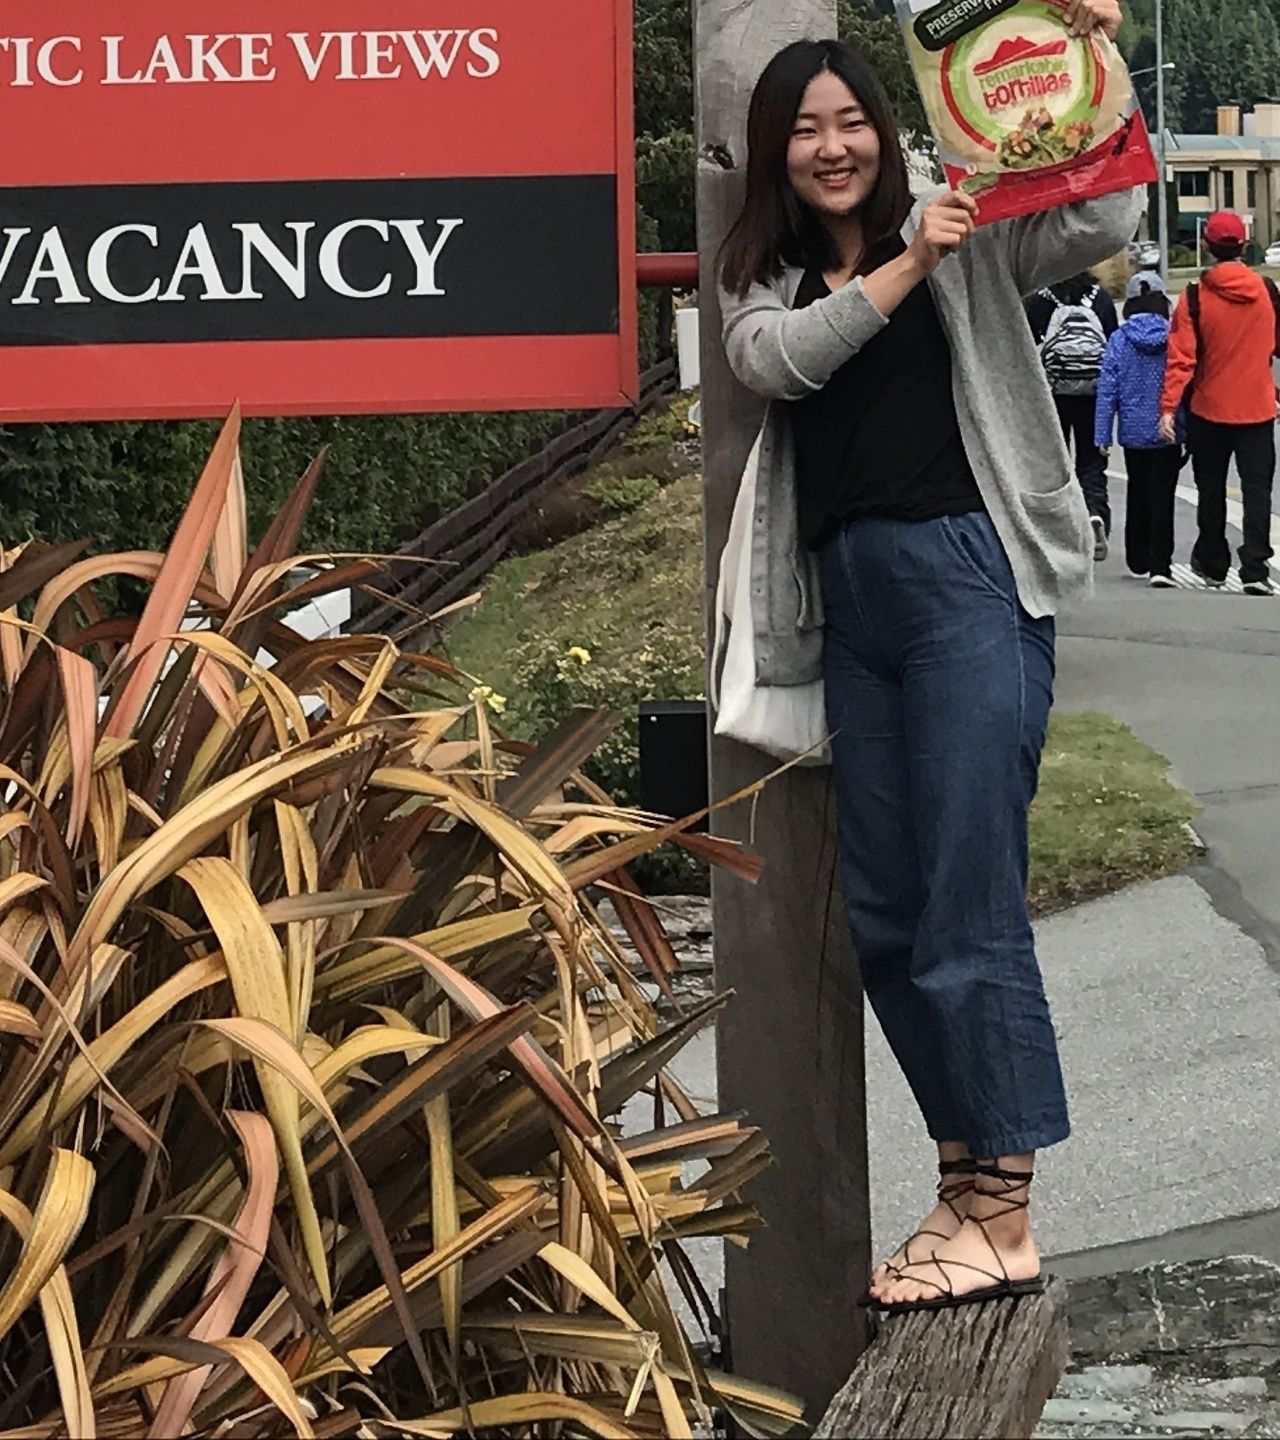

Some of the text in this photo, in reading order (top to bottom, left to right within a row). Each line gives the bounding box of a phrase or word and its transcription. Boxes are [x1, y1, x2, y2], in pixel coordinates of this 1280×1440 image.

[99, 32, 277, 85] LAKE
[285, 27, 501, 82] VIEWS
[982, 72, 1073, 109] tortillas
